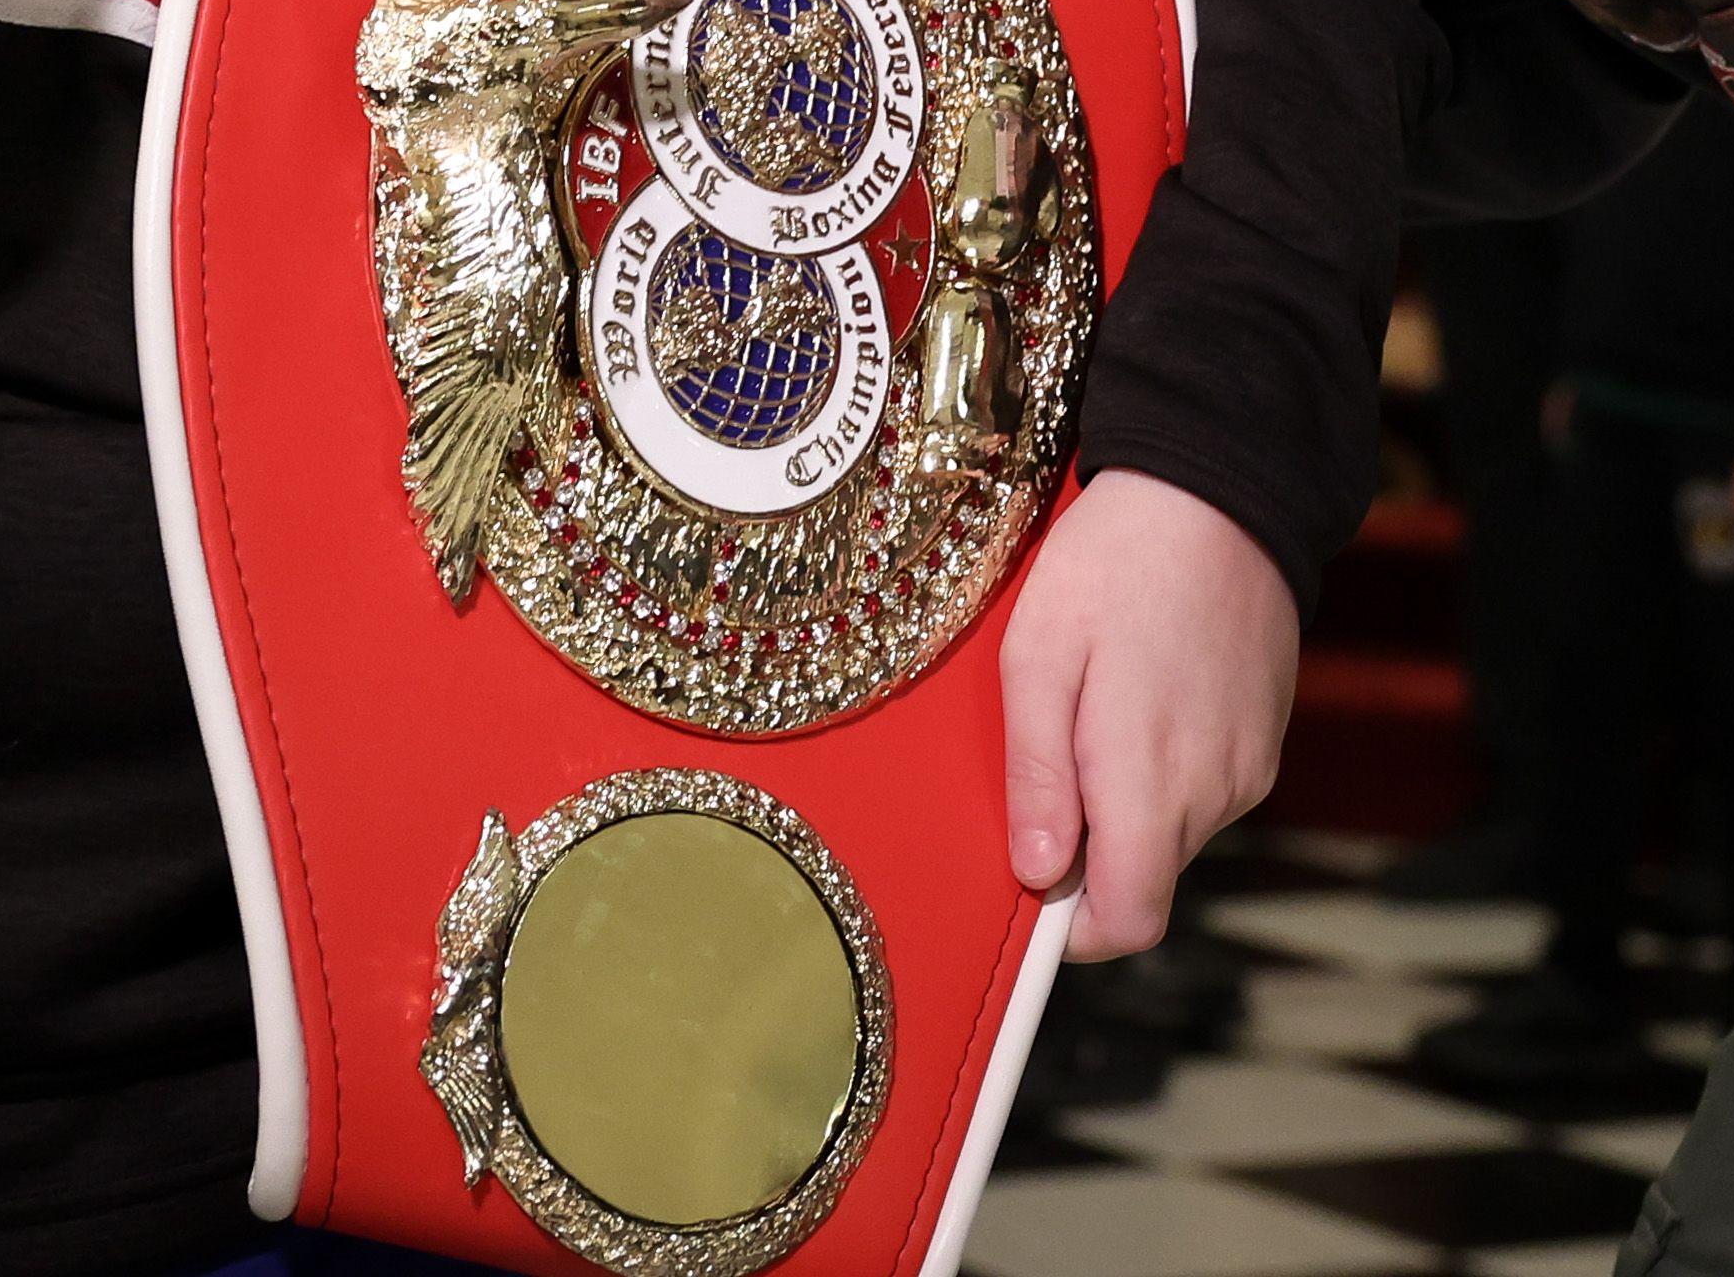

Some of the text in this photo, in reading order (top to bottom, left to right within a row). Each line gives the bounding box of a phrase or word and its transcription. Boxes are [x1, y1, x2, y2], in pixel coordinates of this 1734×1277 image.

[575, 90, 633, 209] IBF
[768, 153, 901, 247] Boxing
[600, 213, 660, 385] World
[783, 254, 886, 490] Champion
